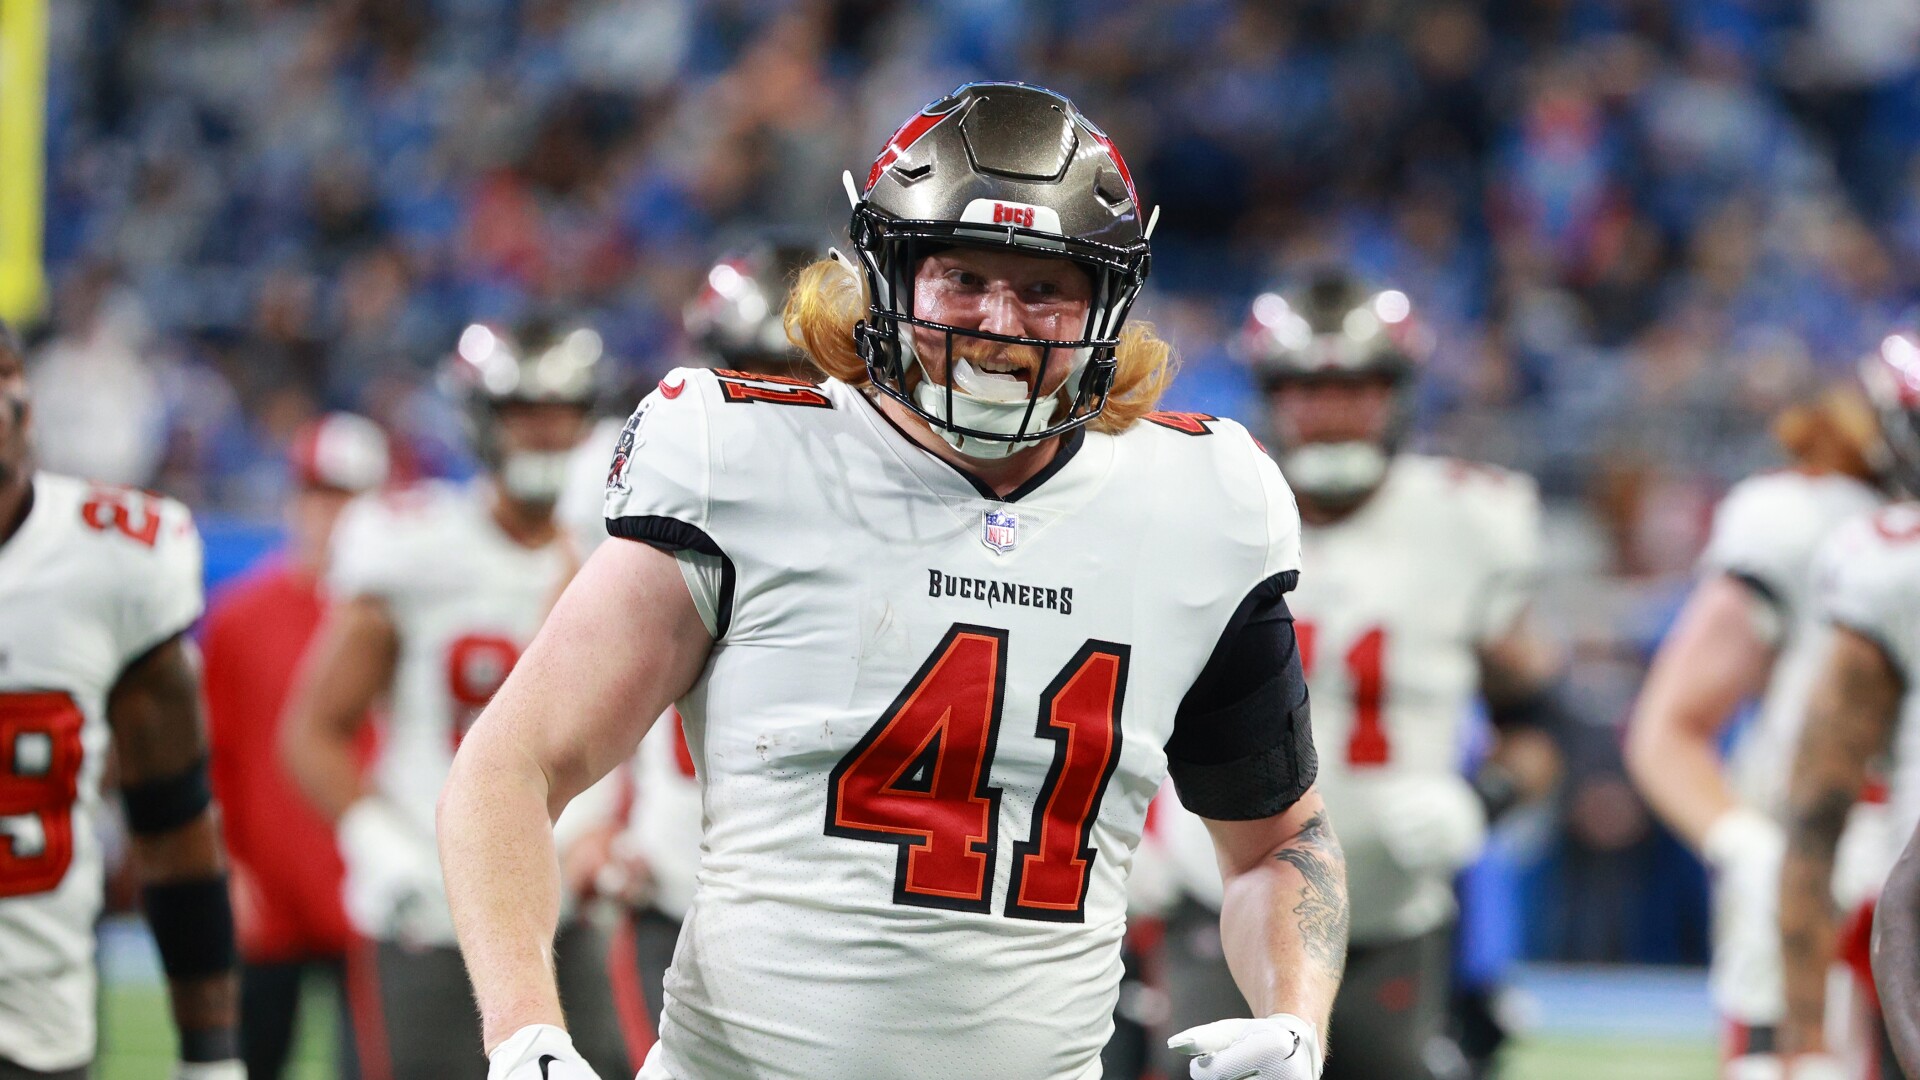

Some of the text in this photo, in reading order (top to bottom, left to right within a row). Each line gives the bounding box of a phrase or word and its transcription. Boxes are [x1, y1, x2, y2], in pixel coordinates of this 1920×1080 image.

[993, 202, 1035, 228] BUCS
[988, 526, 1013, 546] NFL
[927, 568, 1073, 615] BUCCANEERS
[824, 622, 1131, 923] 41
